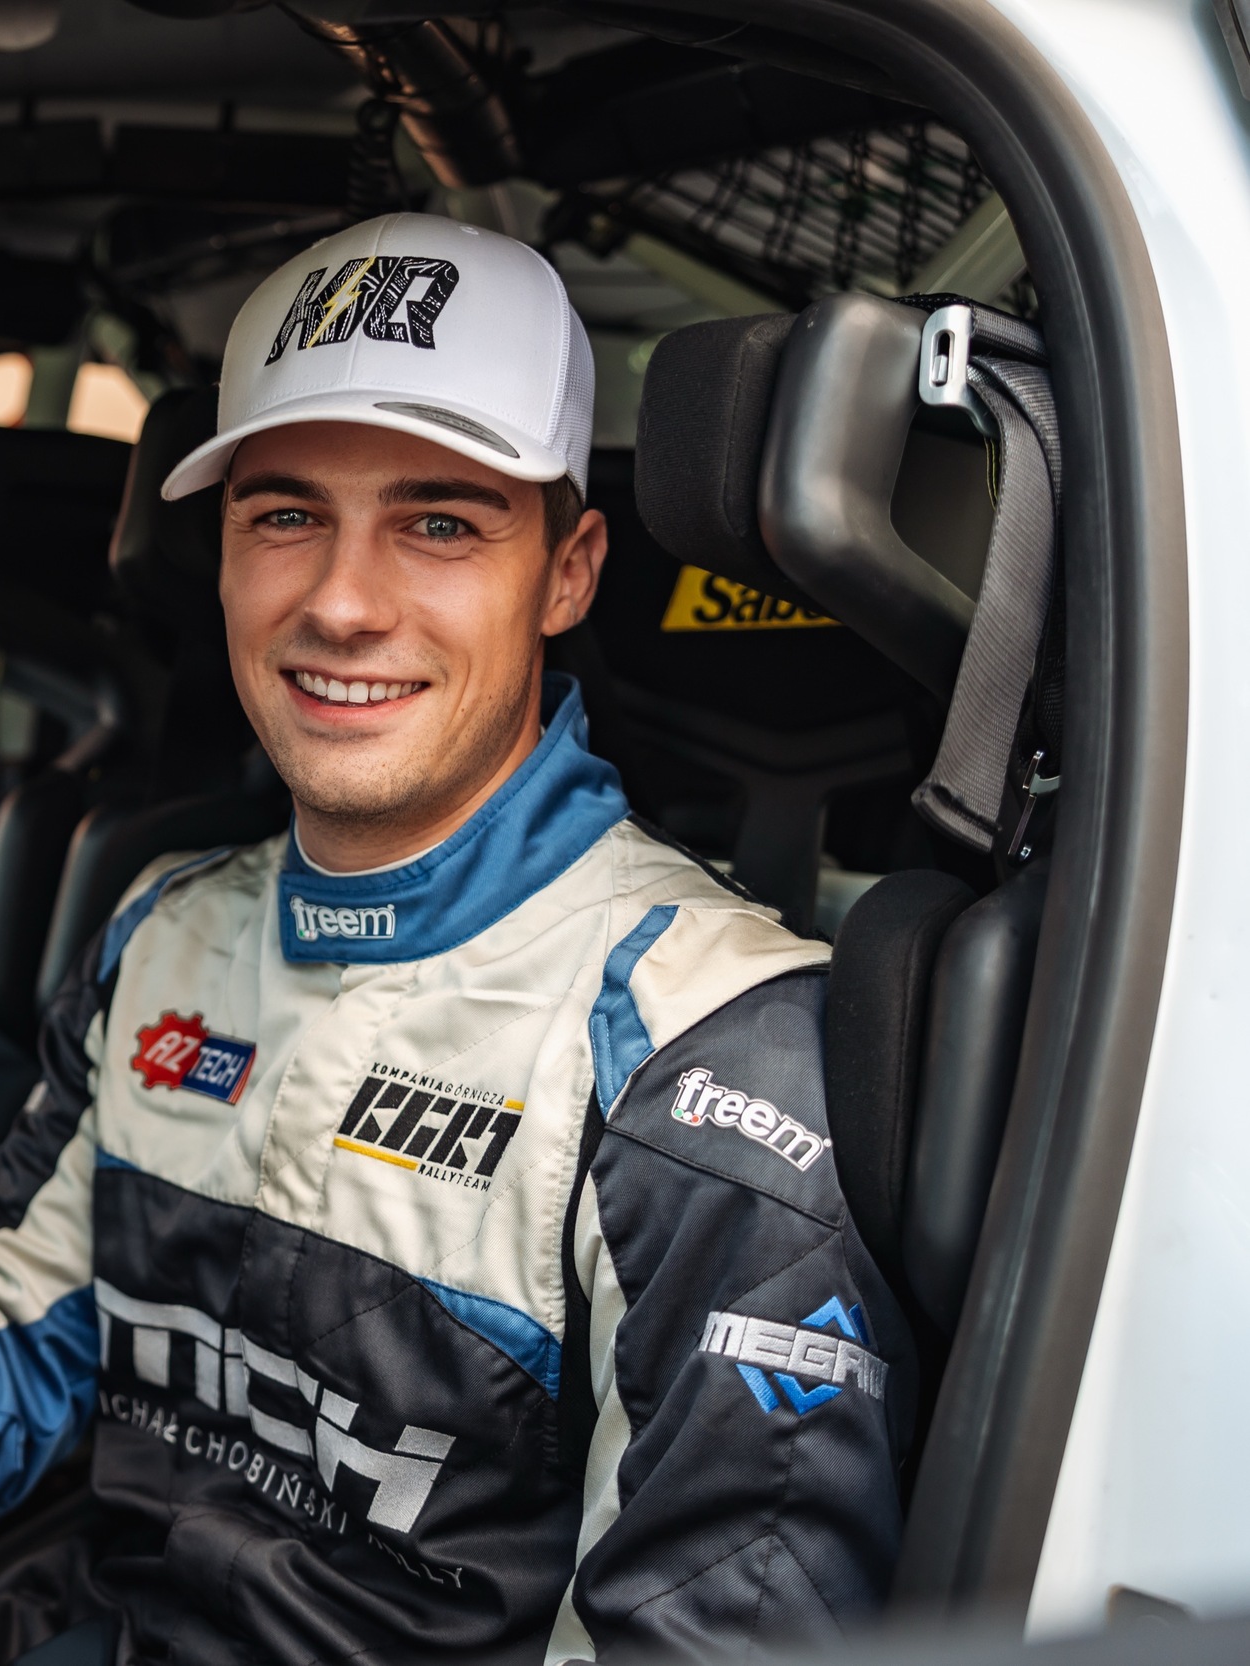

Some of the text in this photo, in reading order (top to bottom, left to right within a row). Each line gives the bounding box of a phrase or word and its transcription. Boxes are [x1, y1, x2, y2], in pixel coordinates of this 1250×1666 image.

[291, 896, 395, 940] freem
[672, 1067, 825, 1171] freem
[99, 1389, 179, 1445] ICHAŁ
[184, 1424, 348, 1535] CHOBIŃSKI
